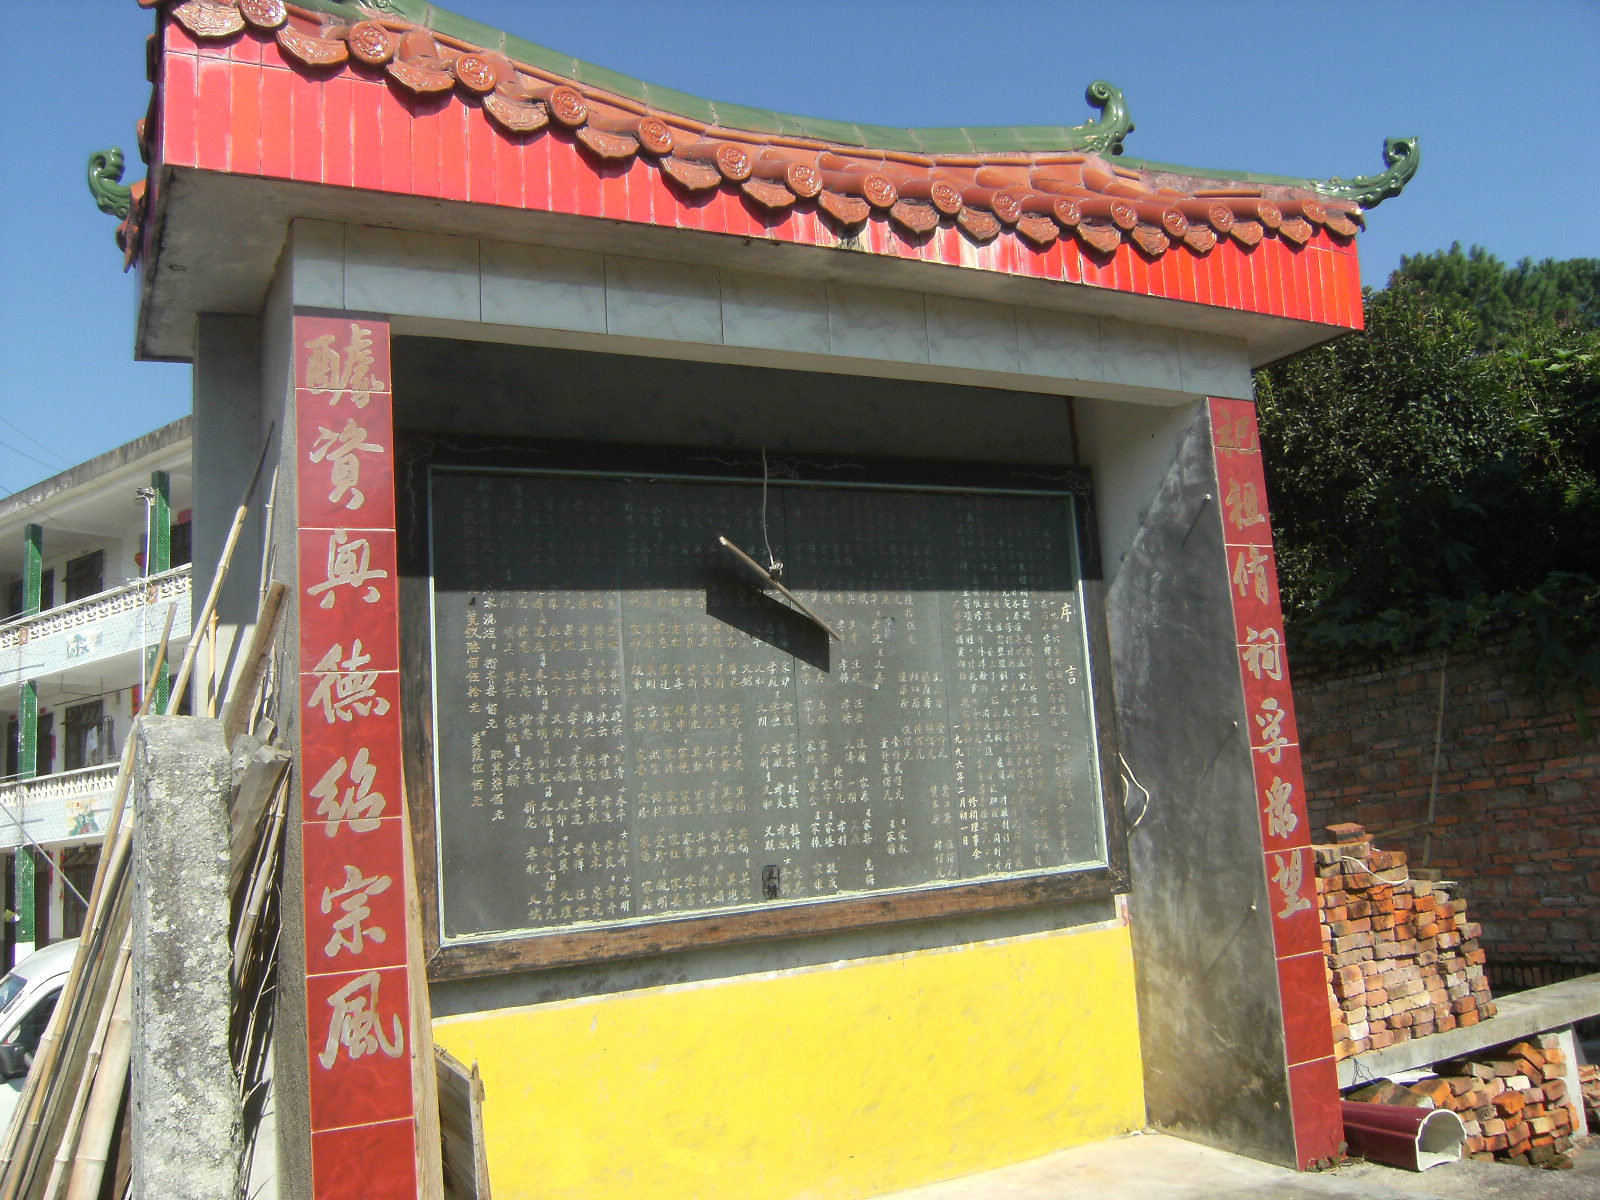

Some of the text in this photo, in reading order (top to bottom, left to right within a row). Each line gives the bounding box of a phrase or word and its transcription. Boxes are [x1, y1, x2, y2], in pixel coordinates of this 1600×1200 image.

[1060, 602, 1078, 685] 序言
[953, 724, 970, 847] 一九九六年二月初一日
